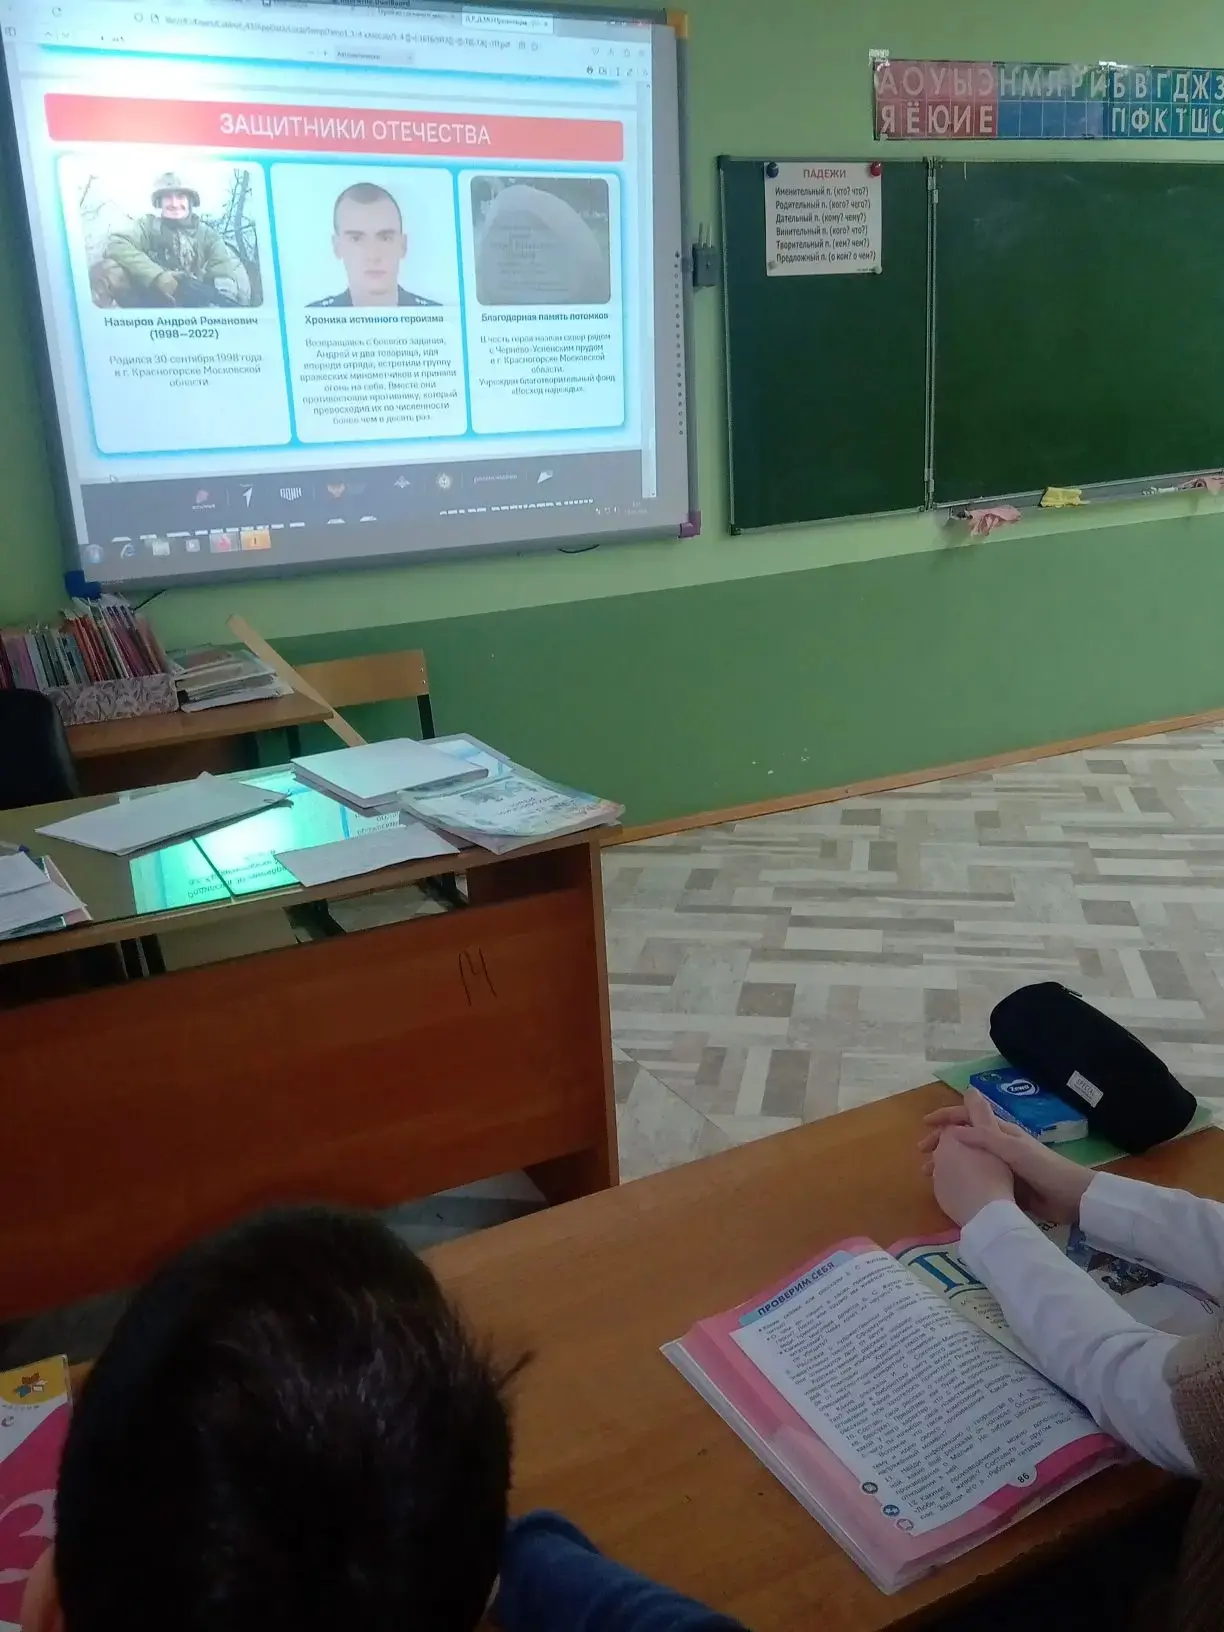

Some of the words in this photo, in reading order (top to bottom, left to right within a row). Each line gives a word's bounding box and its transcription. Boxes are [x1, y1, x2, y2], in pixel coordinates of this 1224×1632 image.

[220, 113, 366, 139] ЗАЩИТНИКИ
[372, 120, 492, 145] ОТЕЧЕСТВА
[803, 169, 846, 178] ПАДЕЖИ
[775, 186, 824, 196] Именительный
[834, 187, 850, 197] (кто?
[852, 187, 868, 196] что?)
[776, 200, 820, 210] Родительный
[829, 200, 849, 210] (кого?
[776, 213, 812, 224] Дательный
[776, 227, 820, 236] Винительный
[777, 240, 823, 250] Творительный
[777, 252, 819, 264] Предложный
[104, 317, 153, 328] Назыров
[157, 316, 197, 327] Андрей
[201, 316, 257, 325] Романович
[305, 316, 346, 325] Хроника
[401, 316, 444, 324] героизма
[482, 313, 536, 322] Благодарная
[217, 354, 238, 362] 1998
[757, 1277, 811, 1316] ПРОВЕРИМ
[811, 1261, 835, 1281] СЕБЯ
[1017, 1472, 1030, 1484] 86
